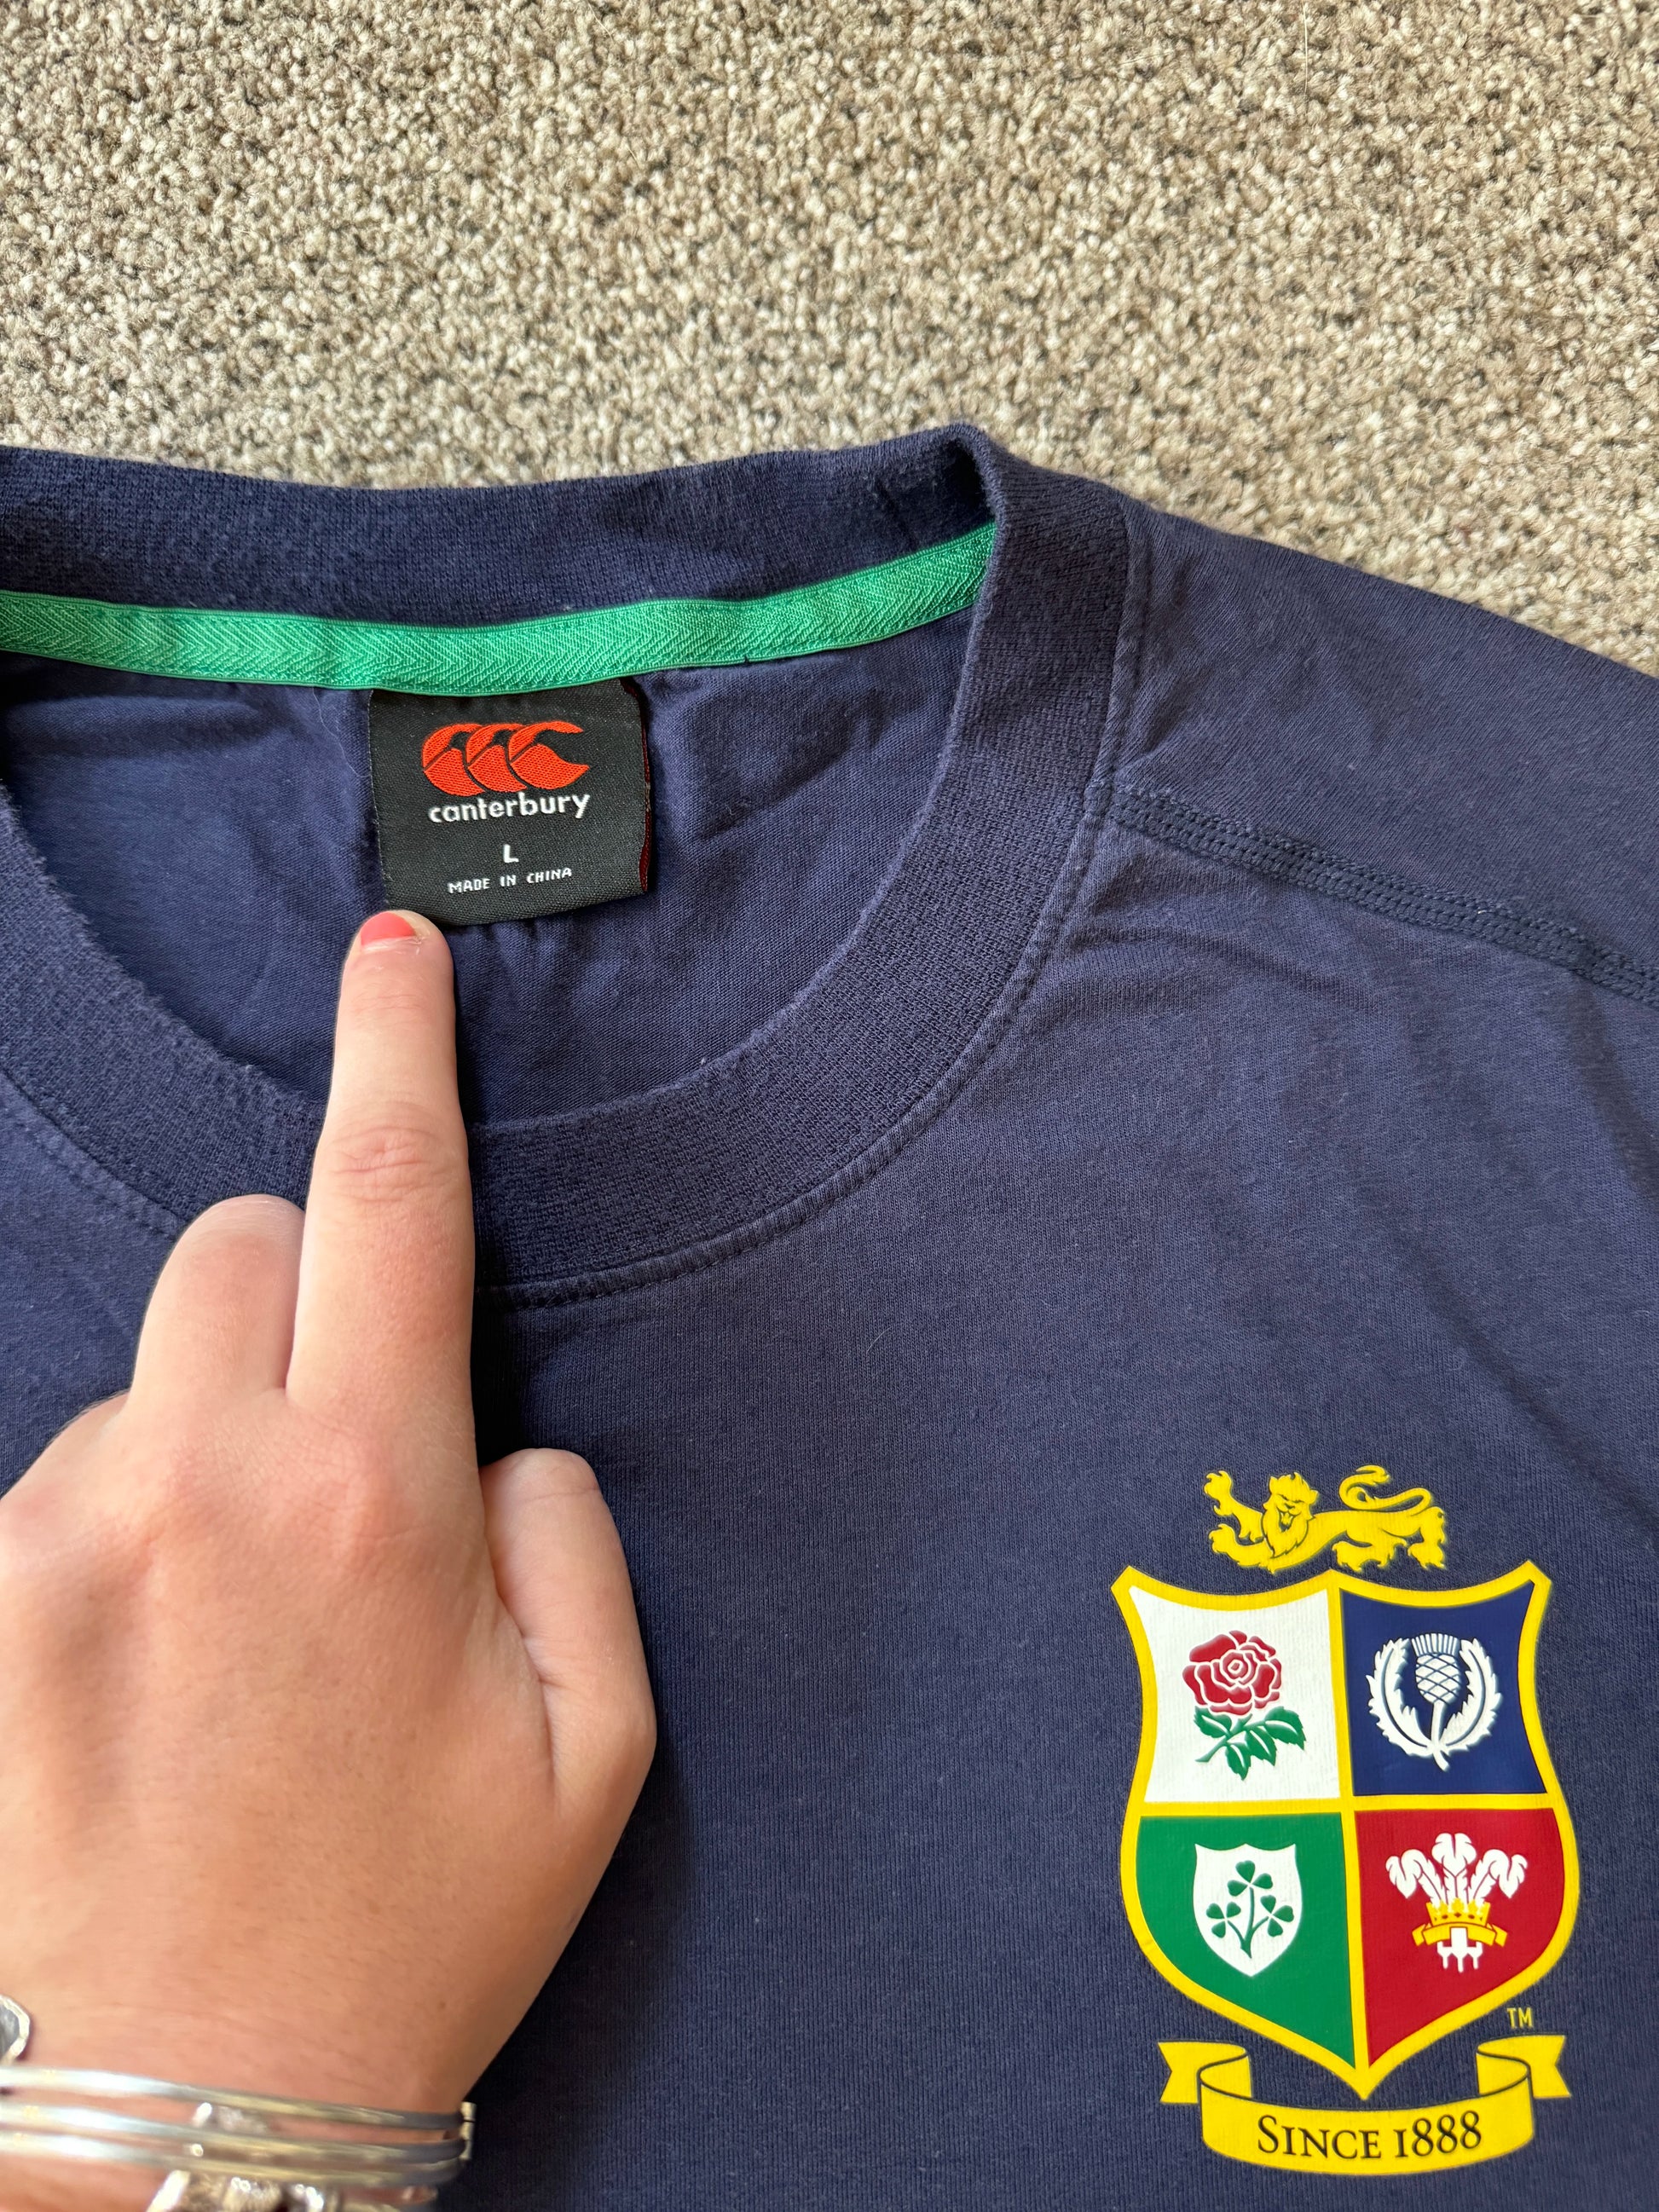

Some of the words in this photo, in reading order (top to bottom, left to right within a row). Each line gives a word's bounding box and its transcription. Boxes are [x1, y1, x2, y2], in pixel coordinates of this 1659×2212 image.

[429, 791, 590, 823] canterbury
[501, 843, 520, 864] L
[447, 878, 490, 894] MADE
[500, 874, 517, 887] IN
[526, 867, 573, 883] CHINA
[1506, 2007, 1534, 2029] TM
[1257, 2115, 1382, 2160] SINCE
[1393, 2110, 1482, 2158] 1888
